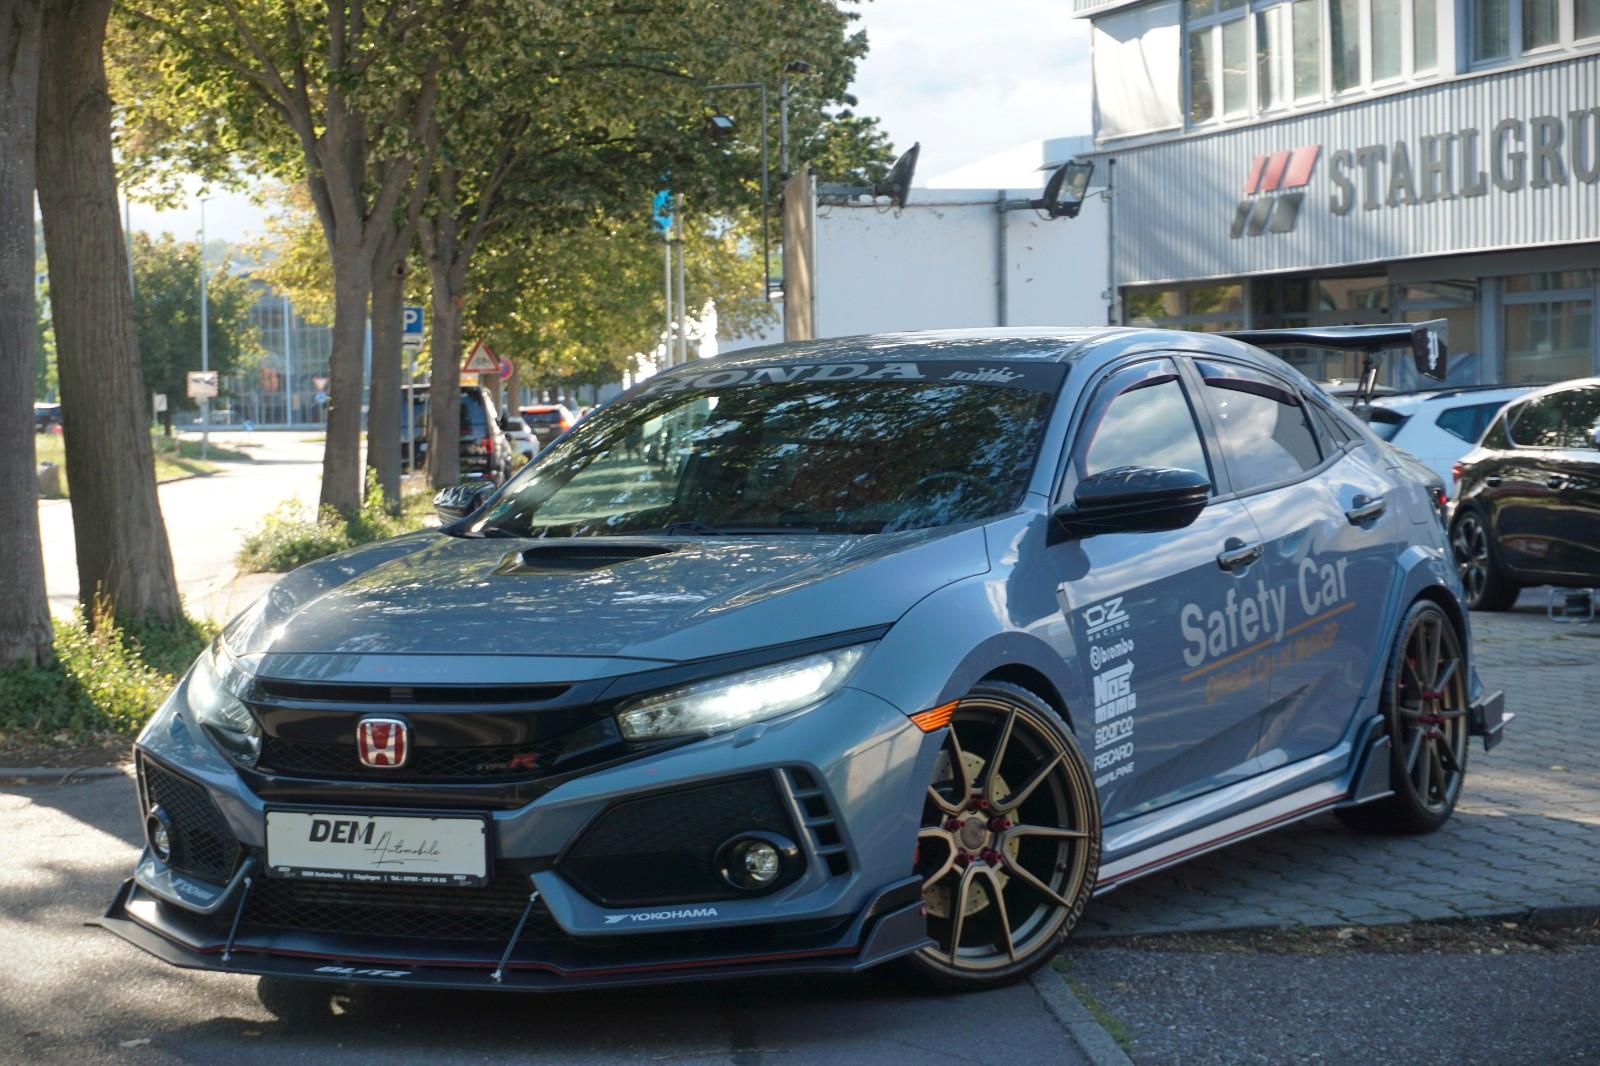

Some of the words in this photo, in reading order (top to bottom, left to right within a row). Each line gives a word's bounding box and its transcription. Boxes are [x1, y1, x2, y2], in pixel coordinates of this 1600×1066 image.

[404, 309, 418, 331] P
[634, 362, 926, 398] HONDA
[1181, 579, 1286, 667] Safety
[1298, 556, 1347, 616] Car
[1095, 715, 1134, 747] sparco
[1094, 742, 1134, 771] RECARO
[308, 819, 376, 845] DEM
[629, 907, 719, 922] YOKOHAMA
